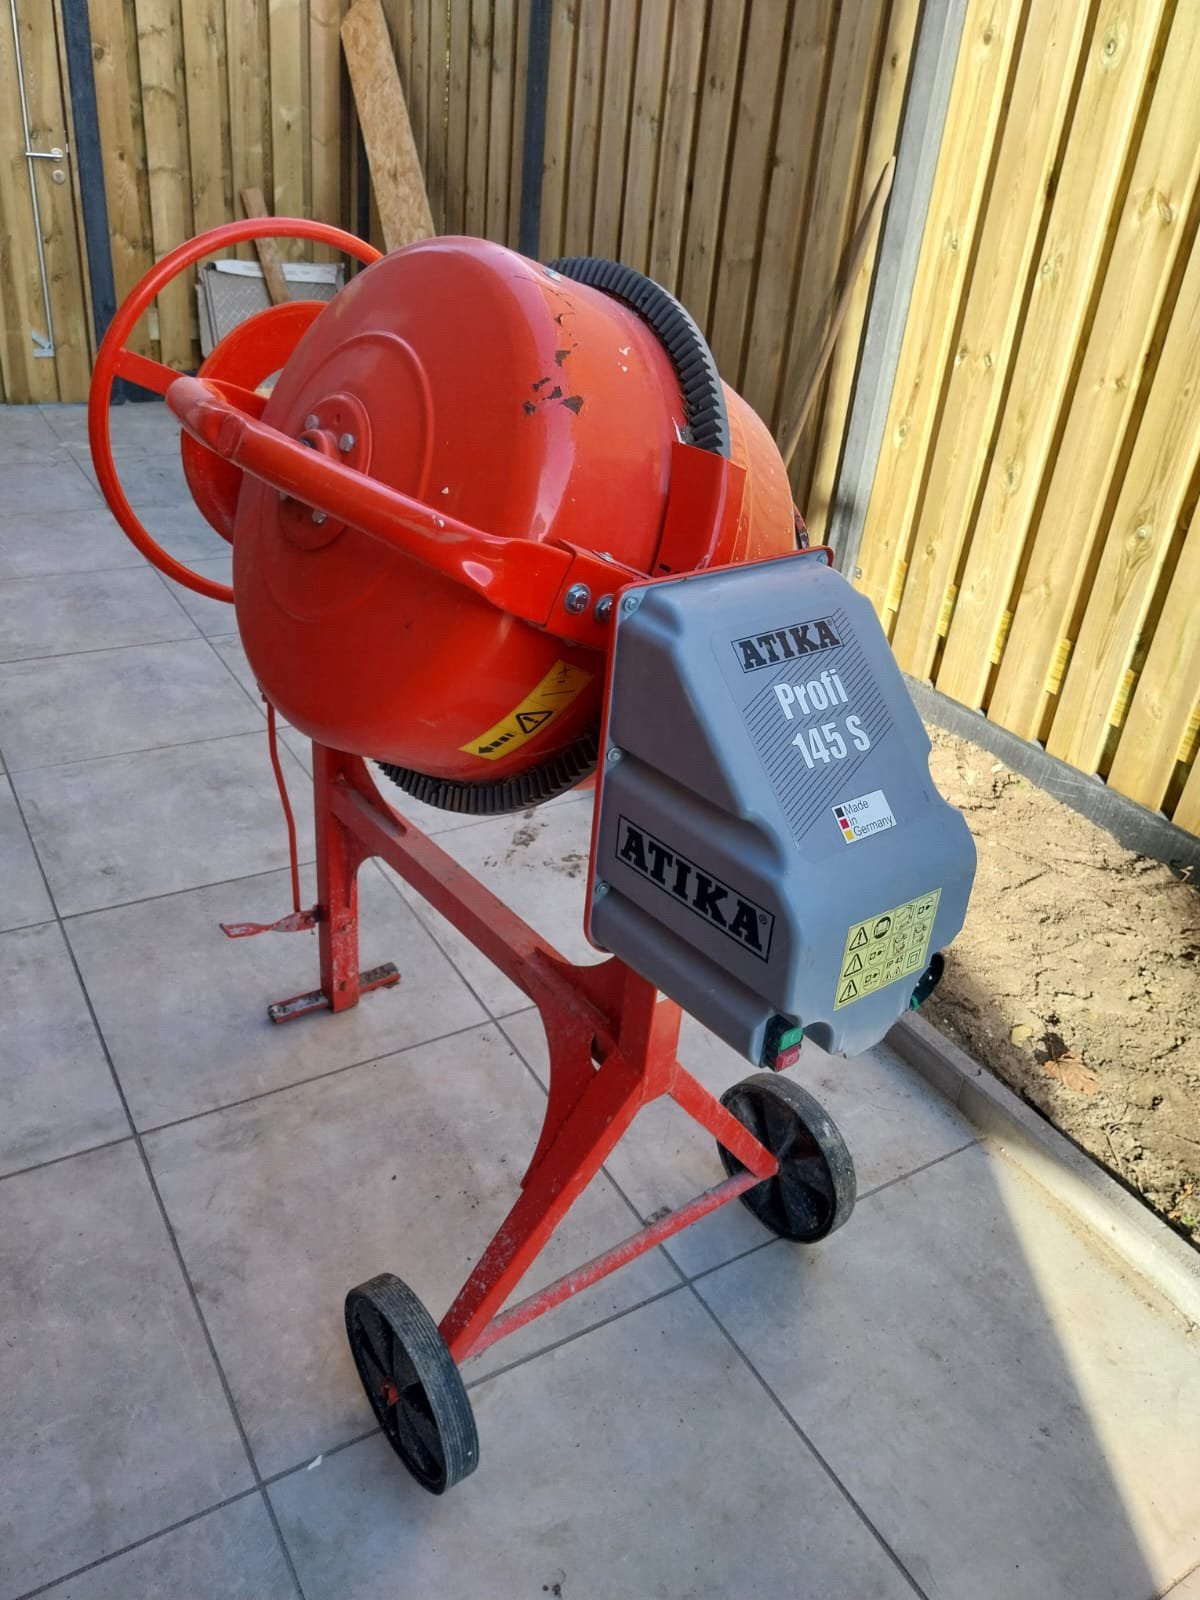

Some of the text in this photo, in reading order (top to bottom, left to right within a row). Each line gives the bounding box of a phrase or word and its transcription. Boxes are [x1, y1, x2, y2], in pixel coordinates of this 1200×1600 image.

[739, 620, 840, 671] ATIKA
[773, 668, 849, 720] Profi
[791, 715, 871, 770] 145 S
[843, 800, 869, 816] Made
[848, 816, 858, 827] in
[853, 815, 893, 837] Germany
[620, 825, 763, 953] ATIKA
